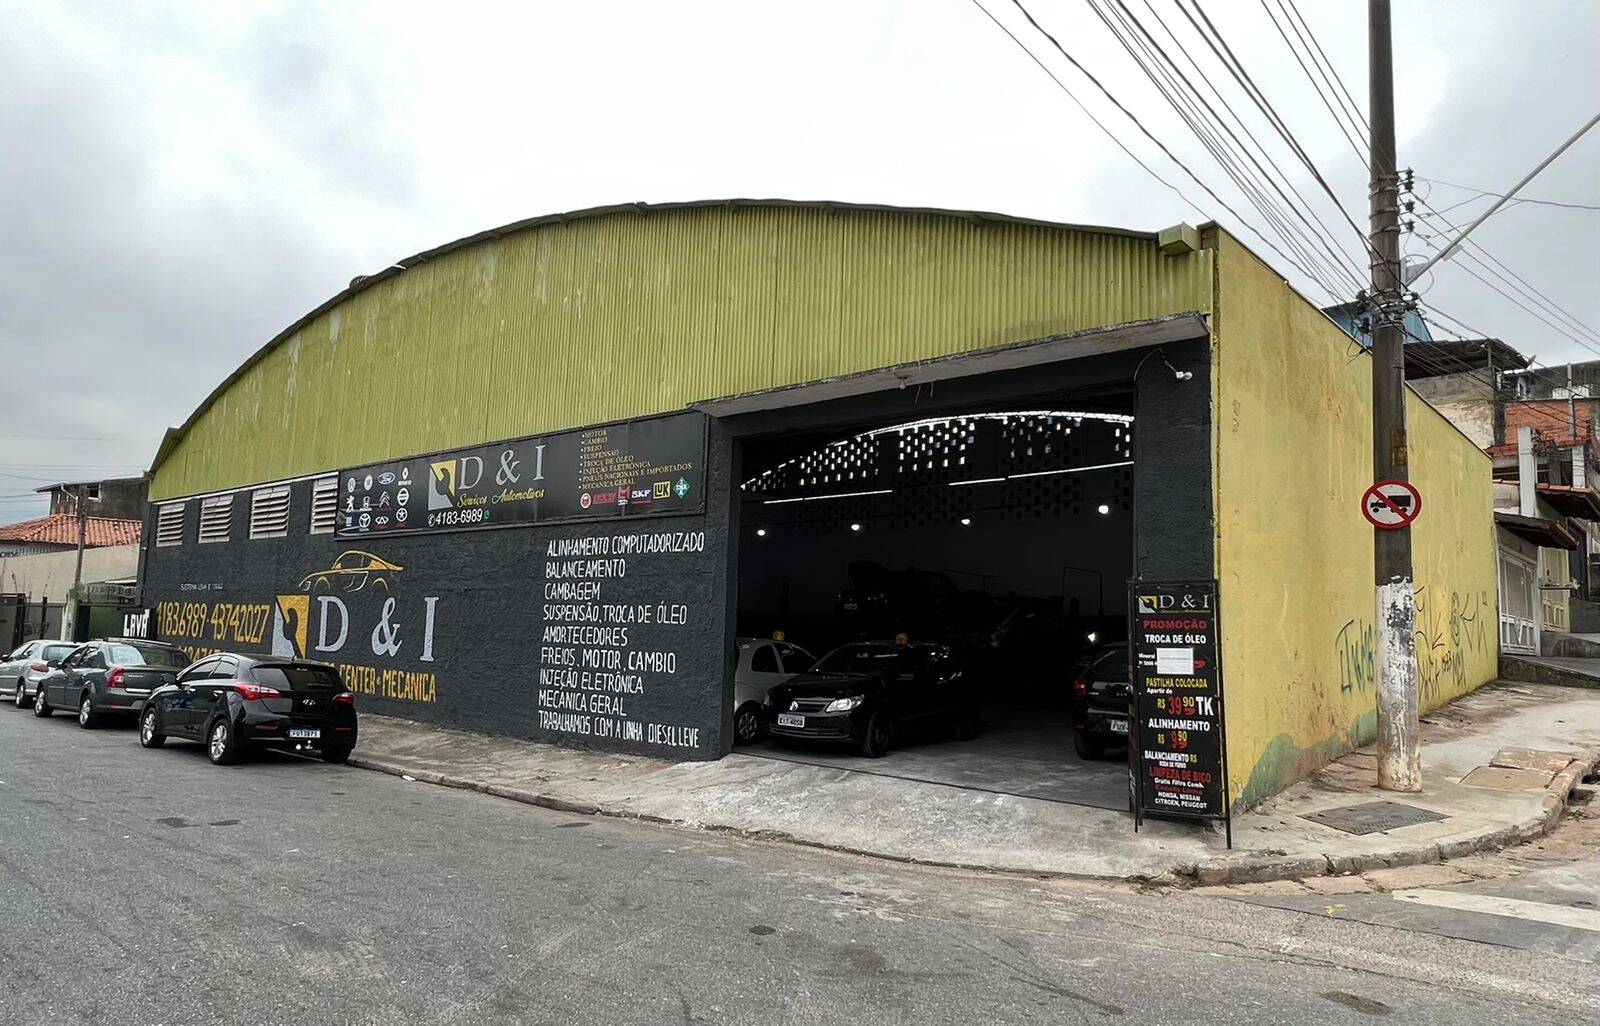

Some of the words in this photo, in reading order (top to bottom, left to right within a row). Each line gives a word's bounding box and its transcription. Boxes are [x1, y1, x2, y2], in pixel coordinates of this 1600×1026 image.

[458, 456, 484, 490] D
[496, 450, 520, 486] &
[533, 445, 546, 481] I
[646, 463, 693, 475] IMPORTADOS
[614, 478, 636, 487] GERAL
[457, 493, 488, 508] Serviços
[492, 488, 545, 505] Automotivos
[632, 490, 652, 499] SKF
[436, 508, 483, 525] 4183-6989
[547, 537, 609, 557] ALINHAMENTO
[612, 532, 705, 555] COMPUTADORIZADO
[546, 559, 625, 578] BALANCEAMENTO
[545, 582, 600, 601] CAMBAGEM
[1159, 595, 1175, 608] D
[1181, 594, 1197, 608] &
[1203, 595, 1209, 608] I
[603, 605, 634, 623] TROCA
[638, 605, 652, 623] DE
[657, 601, 687, 625] ÓLEO
[315, 596, 348, 652] D
[371, 597, 402, 658] &
[420, 597, 440, 662] I
[543, 626, 628, 646] AMORTECEDORES
[1145, 635, 1171, 644] TROCA
[1173, 635, 1184, 644] DE
[1185, 633, 1207, 644] ÓLEO
[629, 651, 676, 674] CAMBIO
[382, 669, 437, 703] MECANICA
[540, 668, 578, 690] INJEÇÃO
[581, 672, 644, 694] ELETRÔNICA
[1146, 678, 1174, 688] PASTILHA
[1175, 679, 1208, 688] COLOCADA
[538, 690, 587, 712] MECANICA
[590, 694, 627, 717] GERAL
[1157, 699, 1166, 709] R$
[1168, 697, 1182, 715] 39
[1183, 697, 1195, 707] 90
[1196, 697, 1214, 716] TK
[538, 710, 591, 735] TRABALHAMOS
[595, 717, 613, 737] COM
[615, 720, 621, 739] A
[623, 720, 643, 742] LINHA
[648, 723, 677, 746] DIESEL
[678, 727, 700, 748] LEVE
[1149, 719, 1210, 732] ALINHAMENTO
[1178, 731, 1188, 741] 90
[1150, 767, 1180, 778] LIMPEZA
[1182, 770, 1192, 780] DE
[1194, 771, 1212, 782] BICO
[1181, 801, 1208, 809] PEUGEOT
